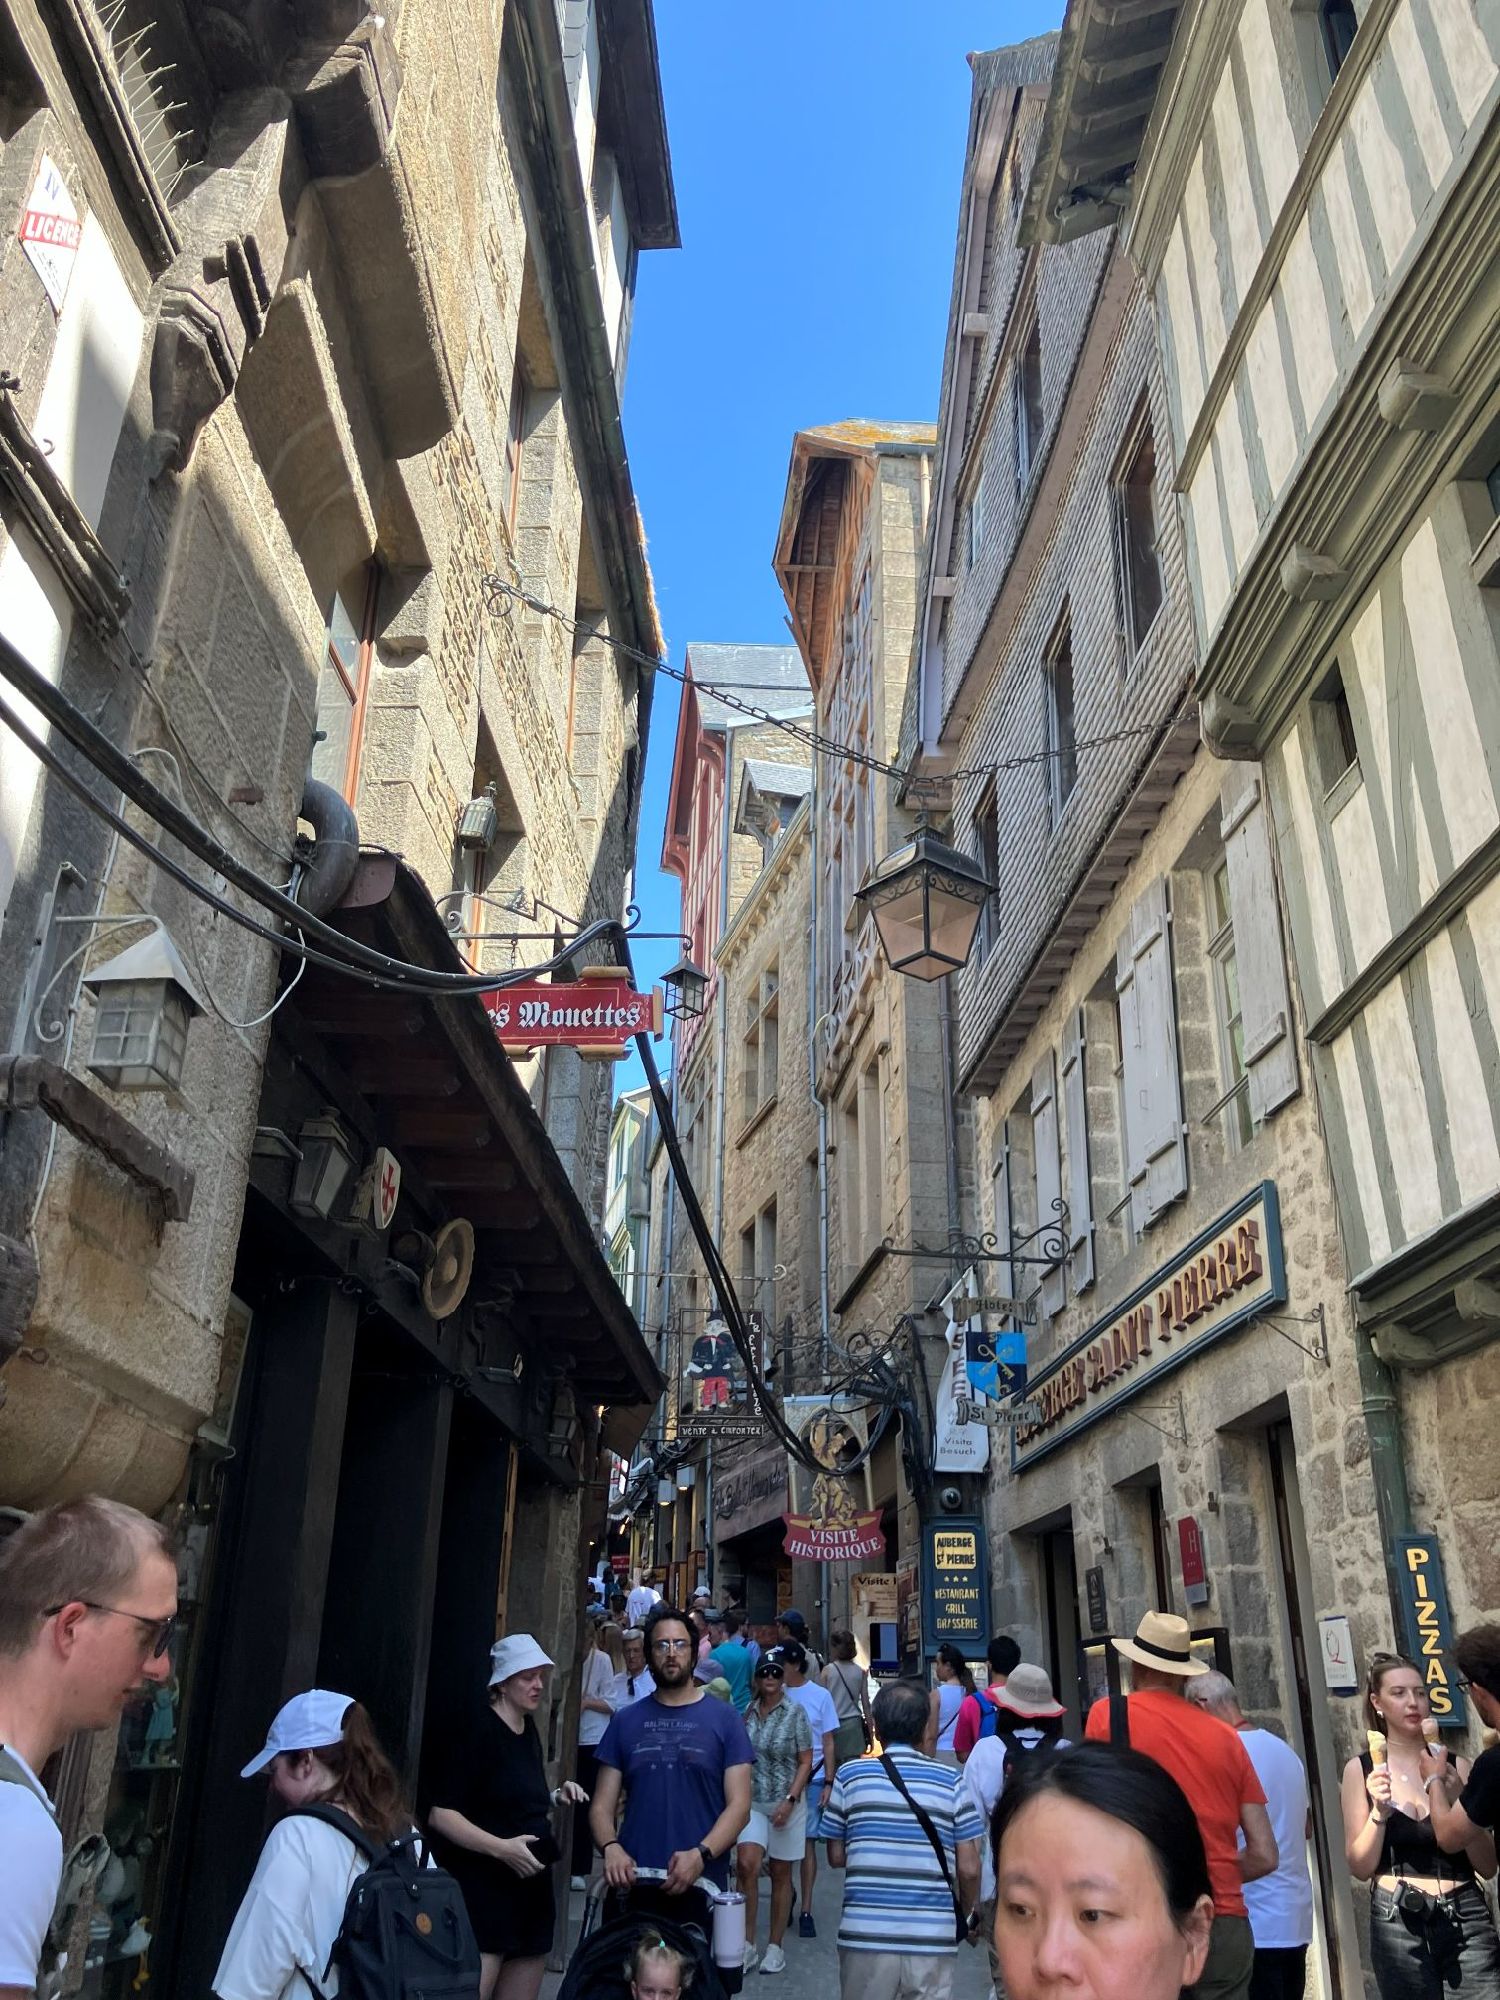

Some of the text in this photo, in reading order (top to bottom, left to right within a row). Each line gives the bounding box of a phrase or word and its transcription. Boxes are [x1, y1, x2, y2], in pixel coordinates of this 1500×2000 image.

[25, 214, 81, 246] LICENCE
[517, 1001, 641, 1028] Mouettes
[1086, 1303, 1153, 1393] SAINT
[1156, 1219, 1263, 1342] PIERRE
[809, 1528, 860, 1545] VISITE
[936, 1537, 973, 1548] AUBERGE
[789, 1536, 882, 1560] HISTORIQUE
[946, 1553, 975, 1565] PIERRE
[857, 1577, 889, 1586] Visite
[935, 1588, 980, 1600] RESTAURANT
[945, 1603, 968, 1615] GRILL
[936, 1617, 978, 1630] BRASSERIE
[1406, 1547, 1453, 1715] PIZZAS
